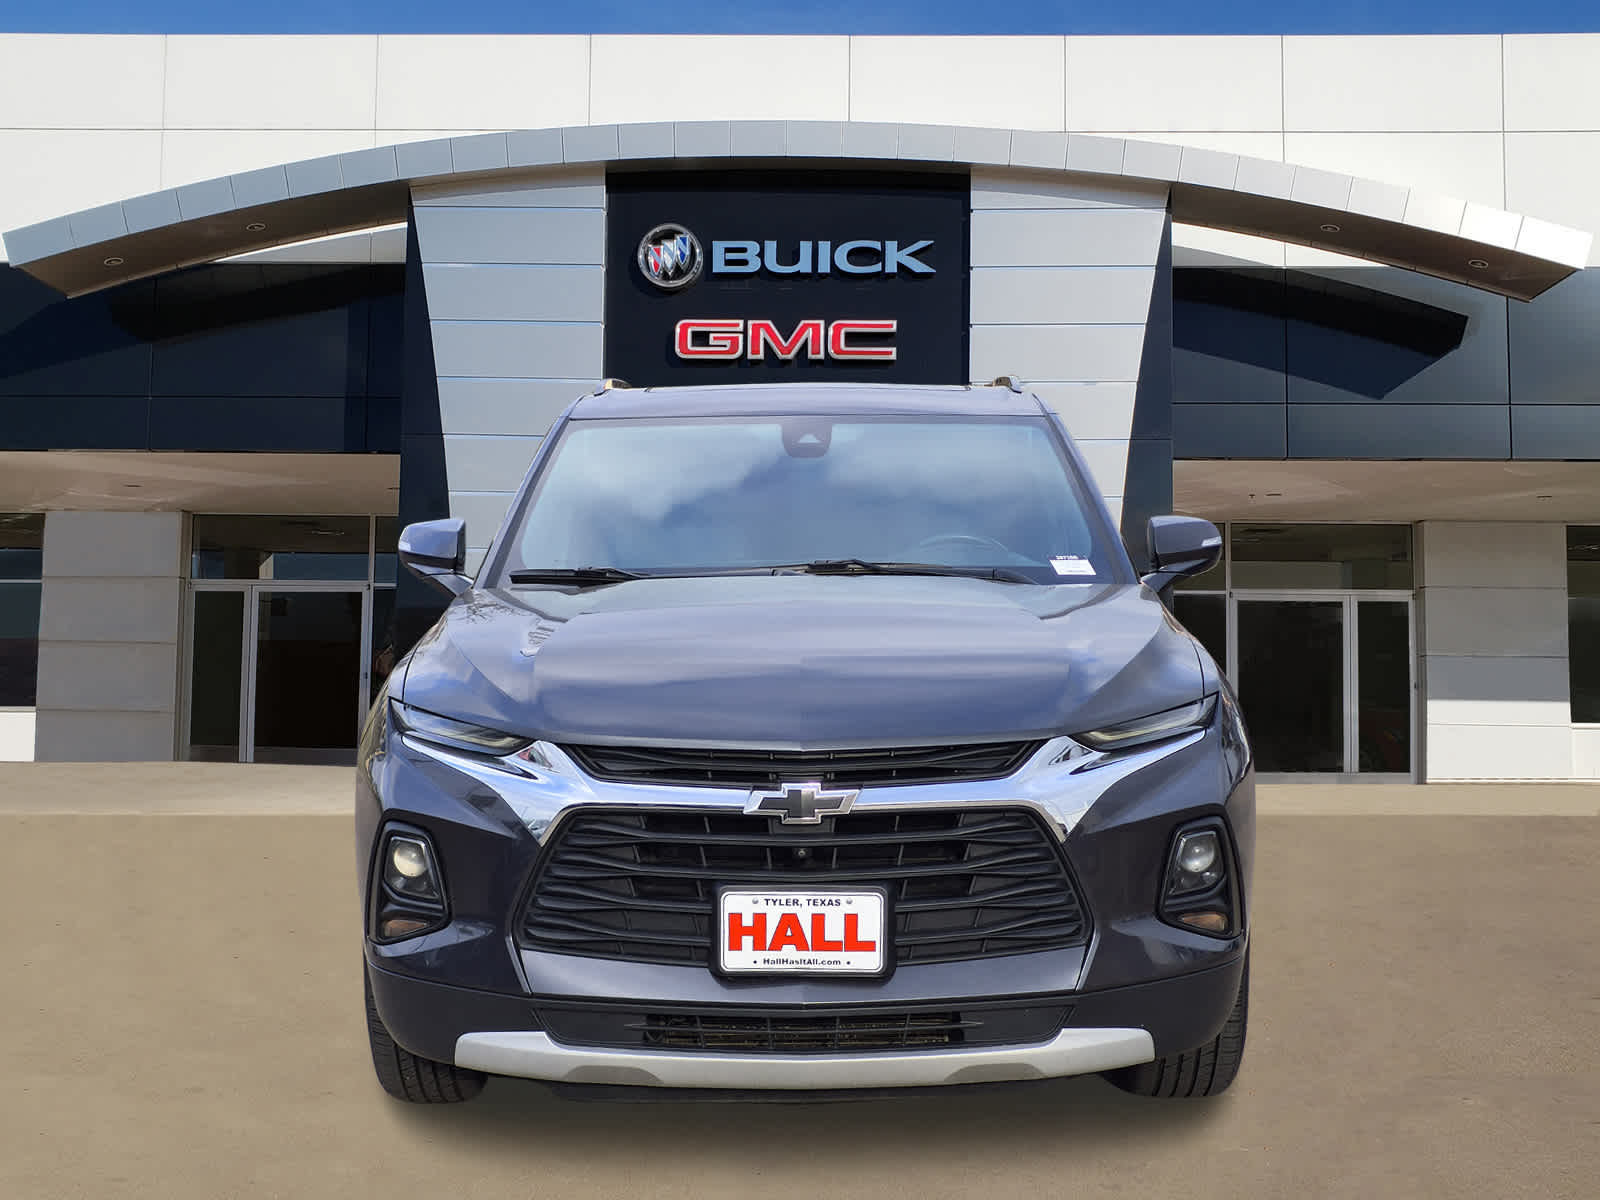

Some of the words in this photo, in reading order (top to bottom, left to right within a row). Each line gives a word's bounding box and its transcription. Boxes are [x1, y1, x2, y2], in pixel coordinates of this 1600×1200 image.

[712, 240, 937, 274] BUICK
[674, 319, 898, 361] GMC
[763, 898, 803, 908] TYLER,
[806, 898, 842, 908] TEXAS
[728, 912, 877, 952] HALL
[763, 958, 842, 967] HallHasItAll.com
